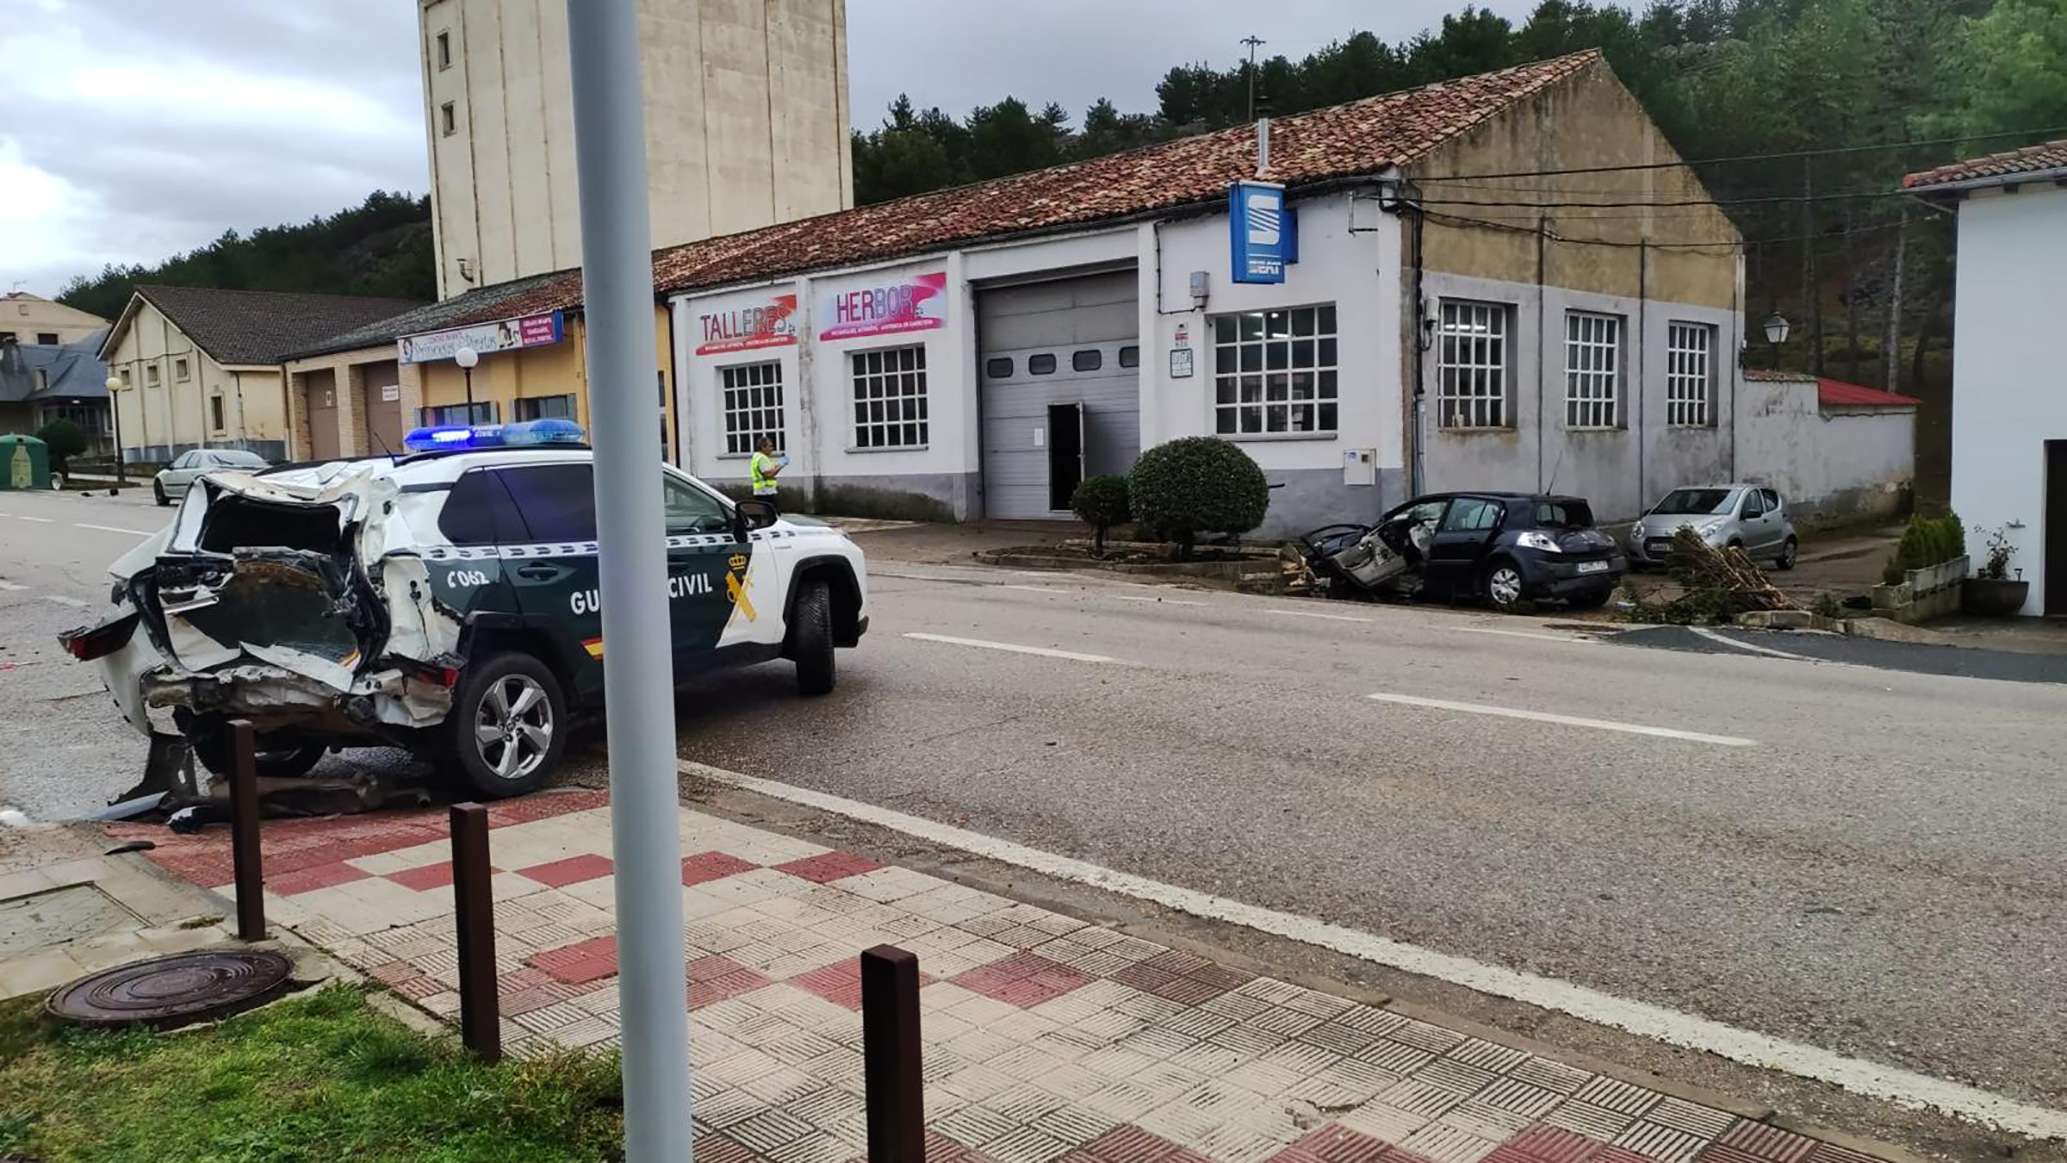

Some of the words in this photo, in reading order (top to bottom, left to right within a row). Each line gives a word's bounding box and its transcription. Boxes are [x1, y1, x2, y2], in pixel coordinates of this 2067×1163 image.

[836, 284, 915, 323] HERBOR
[700, 304, 787, 341] TALLERES
[667, 573, 713, 598] CIVIL
